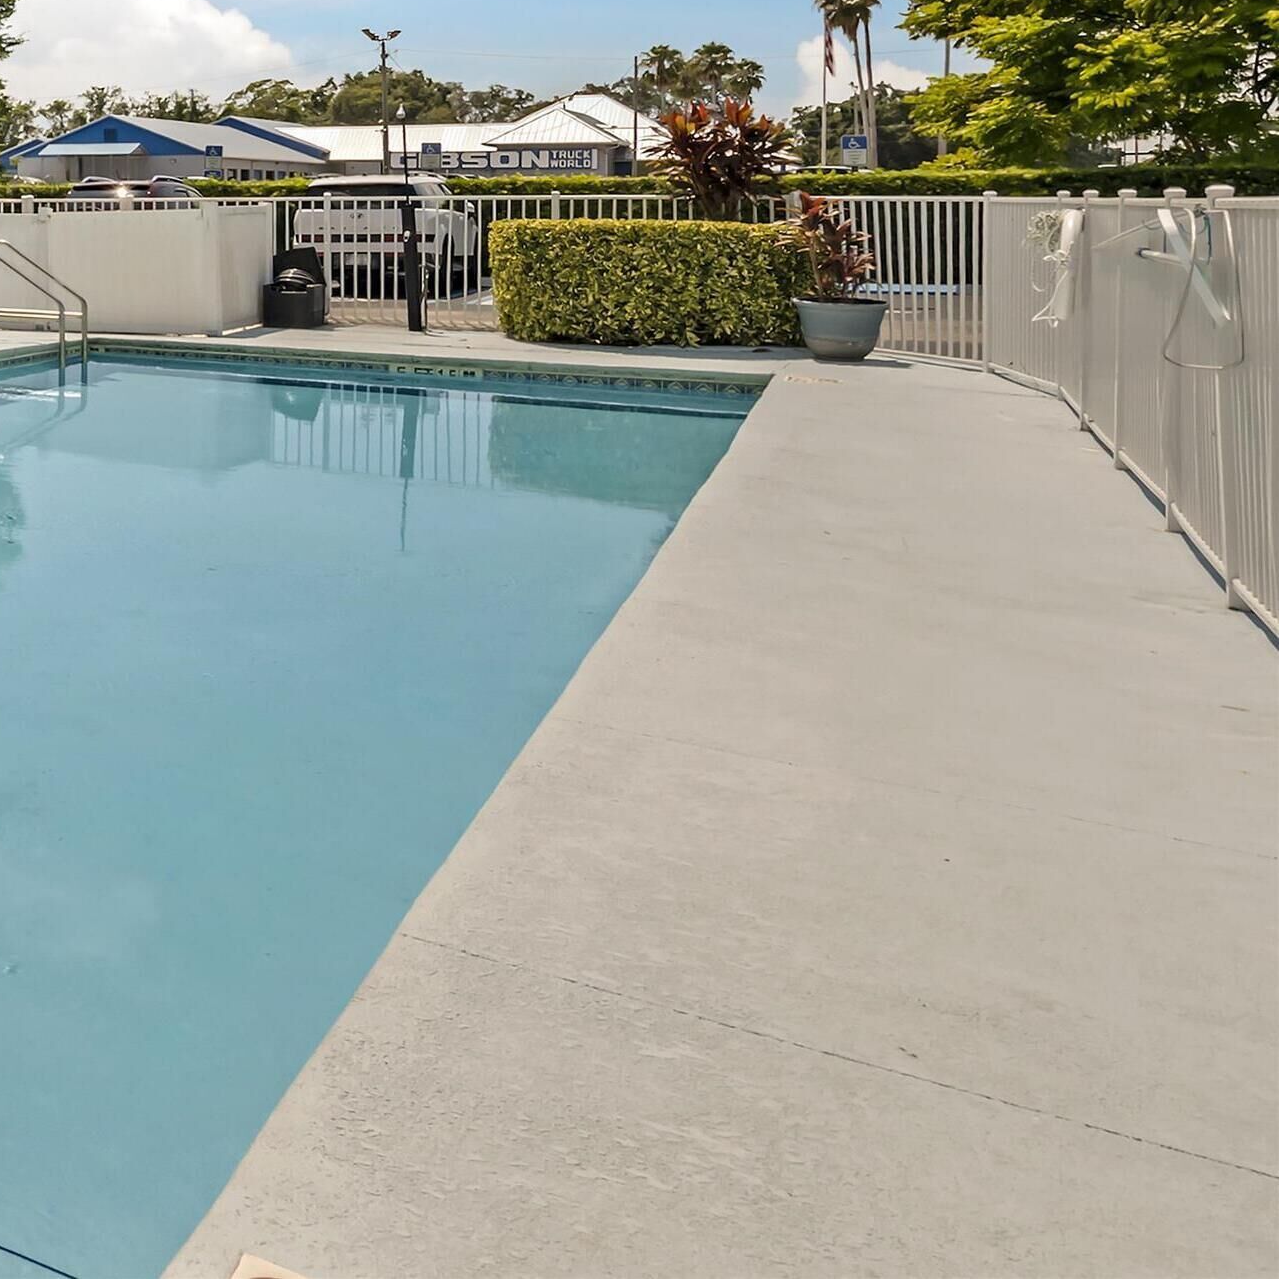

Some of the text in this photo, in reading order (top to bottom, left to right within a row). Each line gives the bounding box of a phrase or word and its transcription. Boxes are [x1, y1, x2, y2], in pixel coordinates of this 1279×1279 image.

[391, 150, 550, 168] GBSON
[550, 149, 591, 159] TRUCK
[549, 158, 591, 168] WORLD
